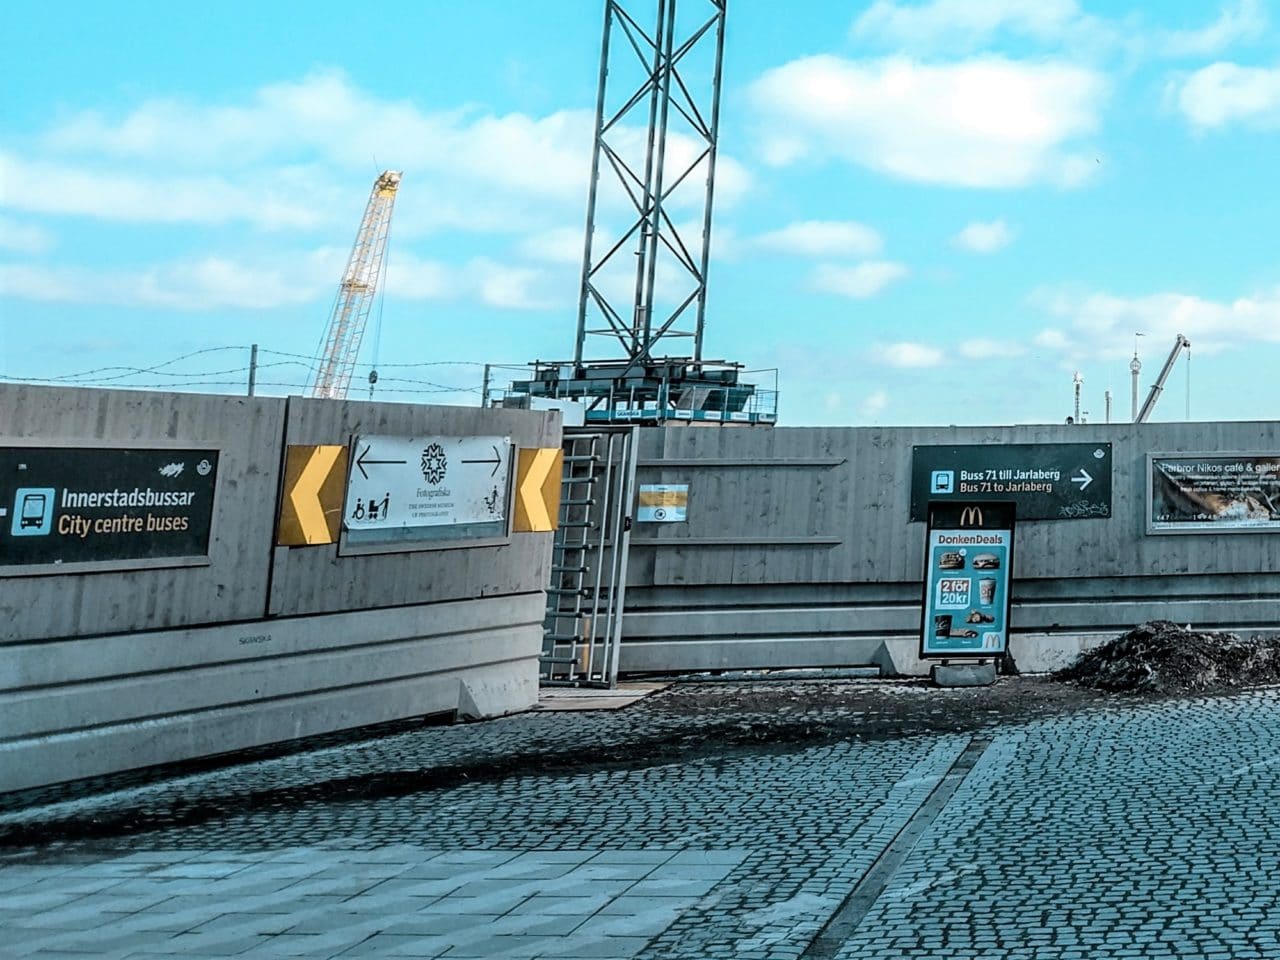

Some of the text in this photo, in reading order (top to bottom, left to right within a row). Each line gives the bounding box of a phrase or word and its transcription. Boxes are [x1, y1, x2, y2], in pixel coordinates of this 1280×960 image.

[1197, 463, 1222, 473] Nikos
[1224, 462, 1244, 472] café
[1246, 463, 1253, 472] &
[961, 468, 1060, 481] Buss 71 till Jarlaberg
[960, 481, 1052, 494] Bus 71 to Jarlaberg
[61, 488, 195, 508] Innerstadsbussar
[58, 513, 189, 538] City centre buses
[942, 581, 950, 592] 2
[951, 580, 968, 592] för
